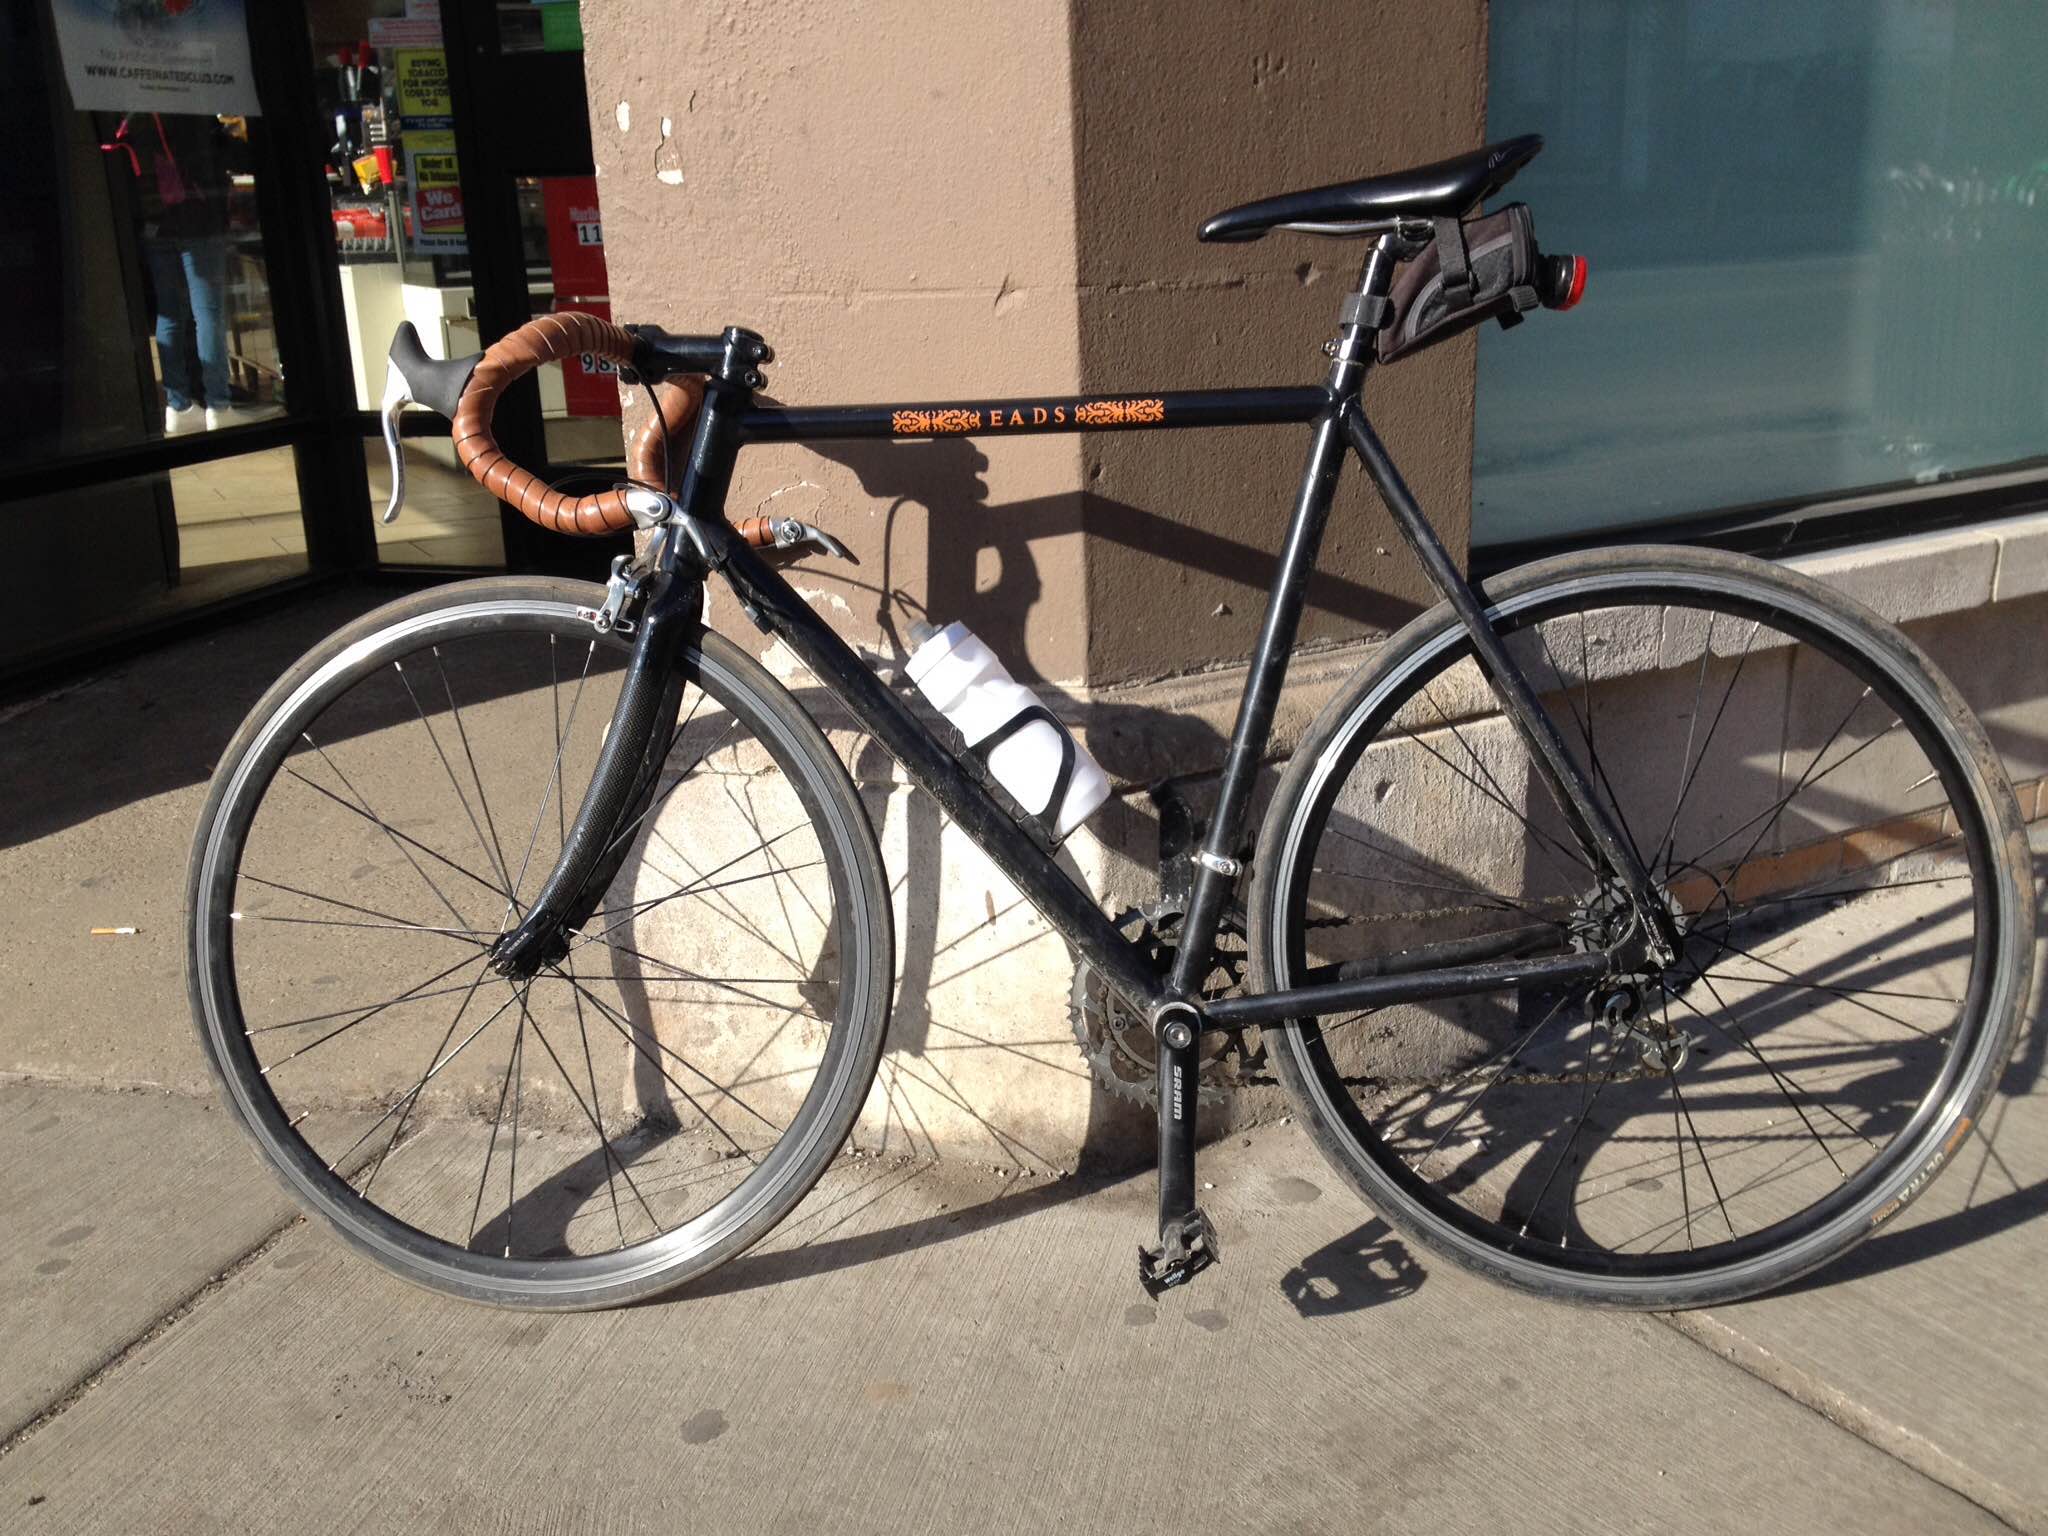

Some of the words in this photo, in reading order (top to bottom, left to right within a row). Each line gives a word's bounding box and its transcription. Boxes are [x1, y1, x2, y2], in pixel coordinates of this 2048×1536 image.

[407, 68, 446, 78] TOBACCO
[421, 79, 449, 88] MINOR
[432, 88, 449, 97] COS
[424, 190, 455, 207] We
[421, 202, 463, 221] Card
[990, 406, 1065, 427] EADS
[1173, 1065, 1182, 1120] SRAM
